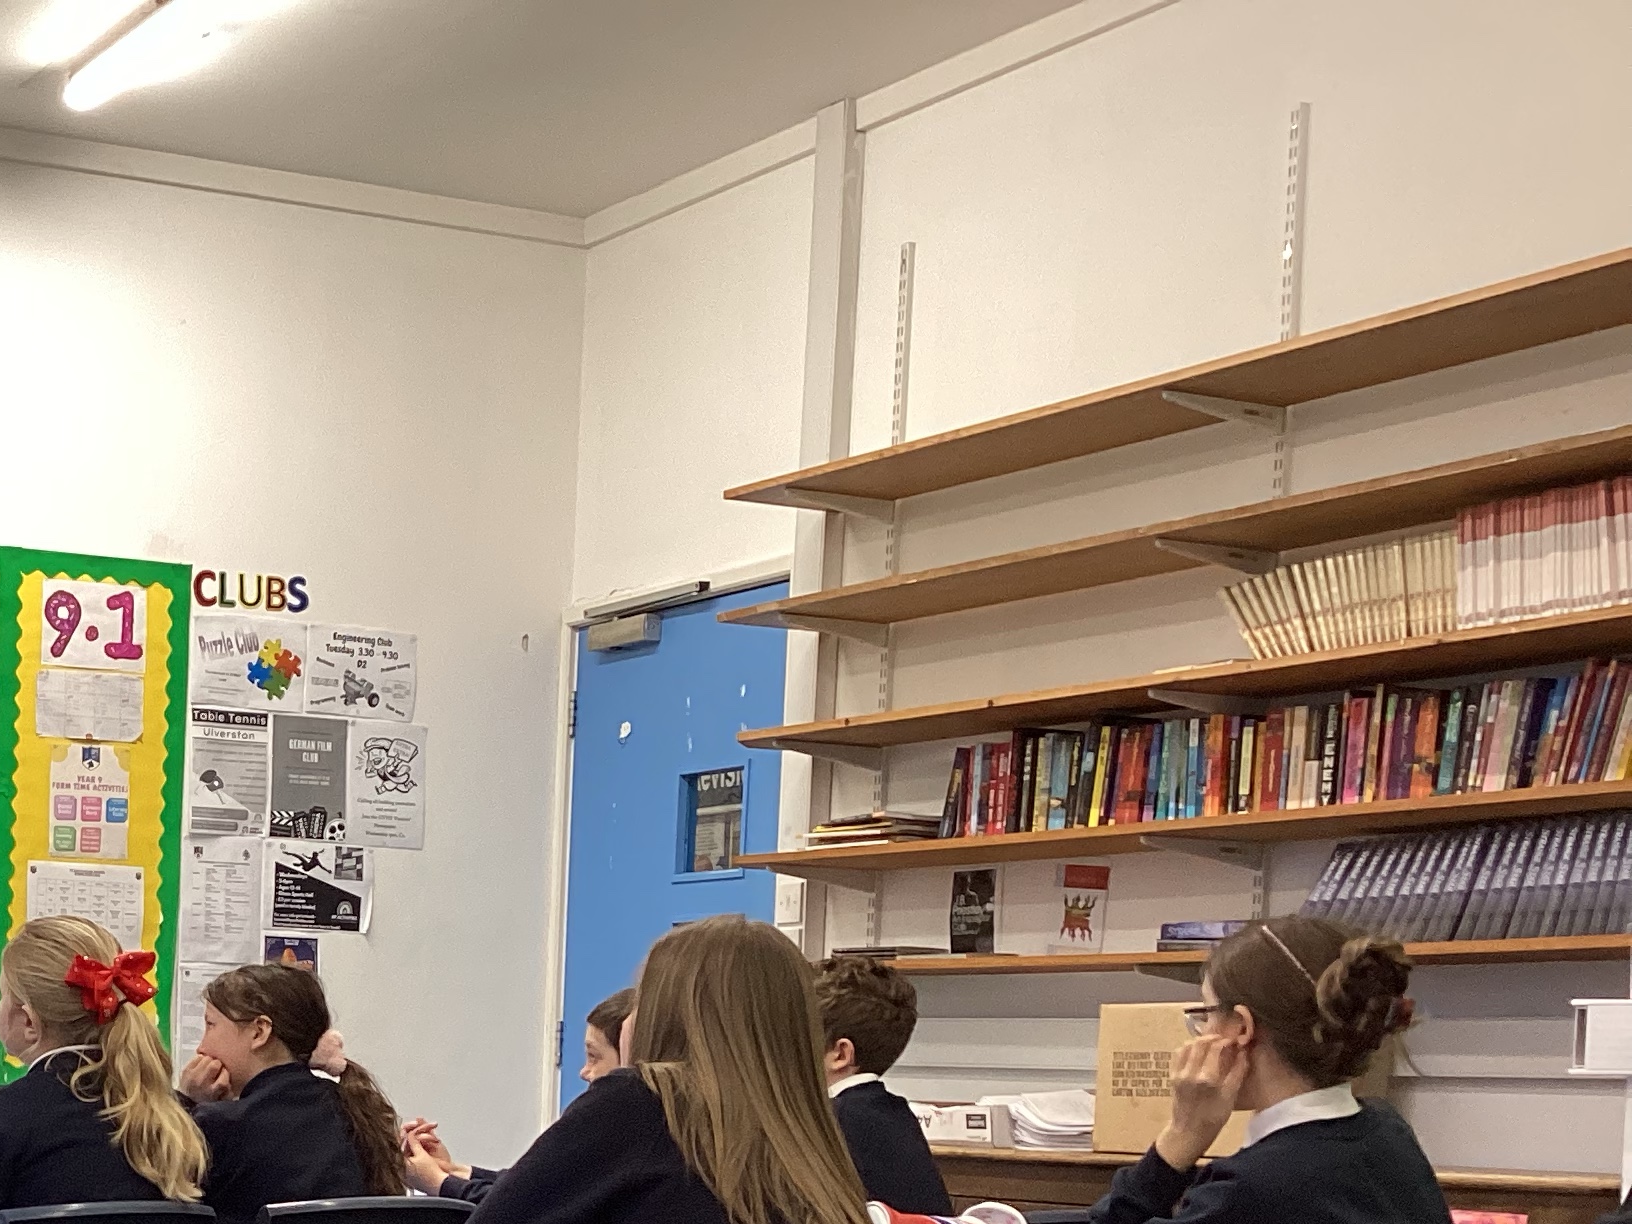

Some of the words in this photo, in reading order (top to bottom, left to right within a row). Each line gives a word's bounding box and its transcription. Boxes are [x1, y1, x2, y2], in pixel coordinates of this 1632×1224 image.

[193, 569, 309, 613] CLUBS
[198, 631, 235, 660] Puzzle
[333, 632, 375, 648] Engineering
[377, 637, 393, 647] Club
[326, 644, 354, 657] Tuesday
[193, 710, 225, 722] Table
[228, 713, 267, 725] Tennis
[204, 727, 255, 740] Ulverston
